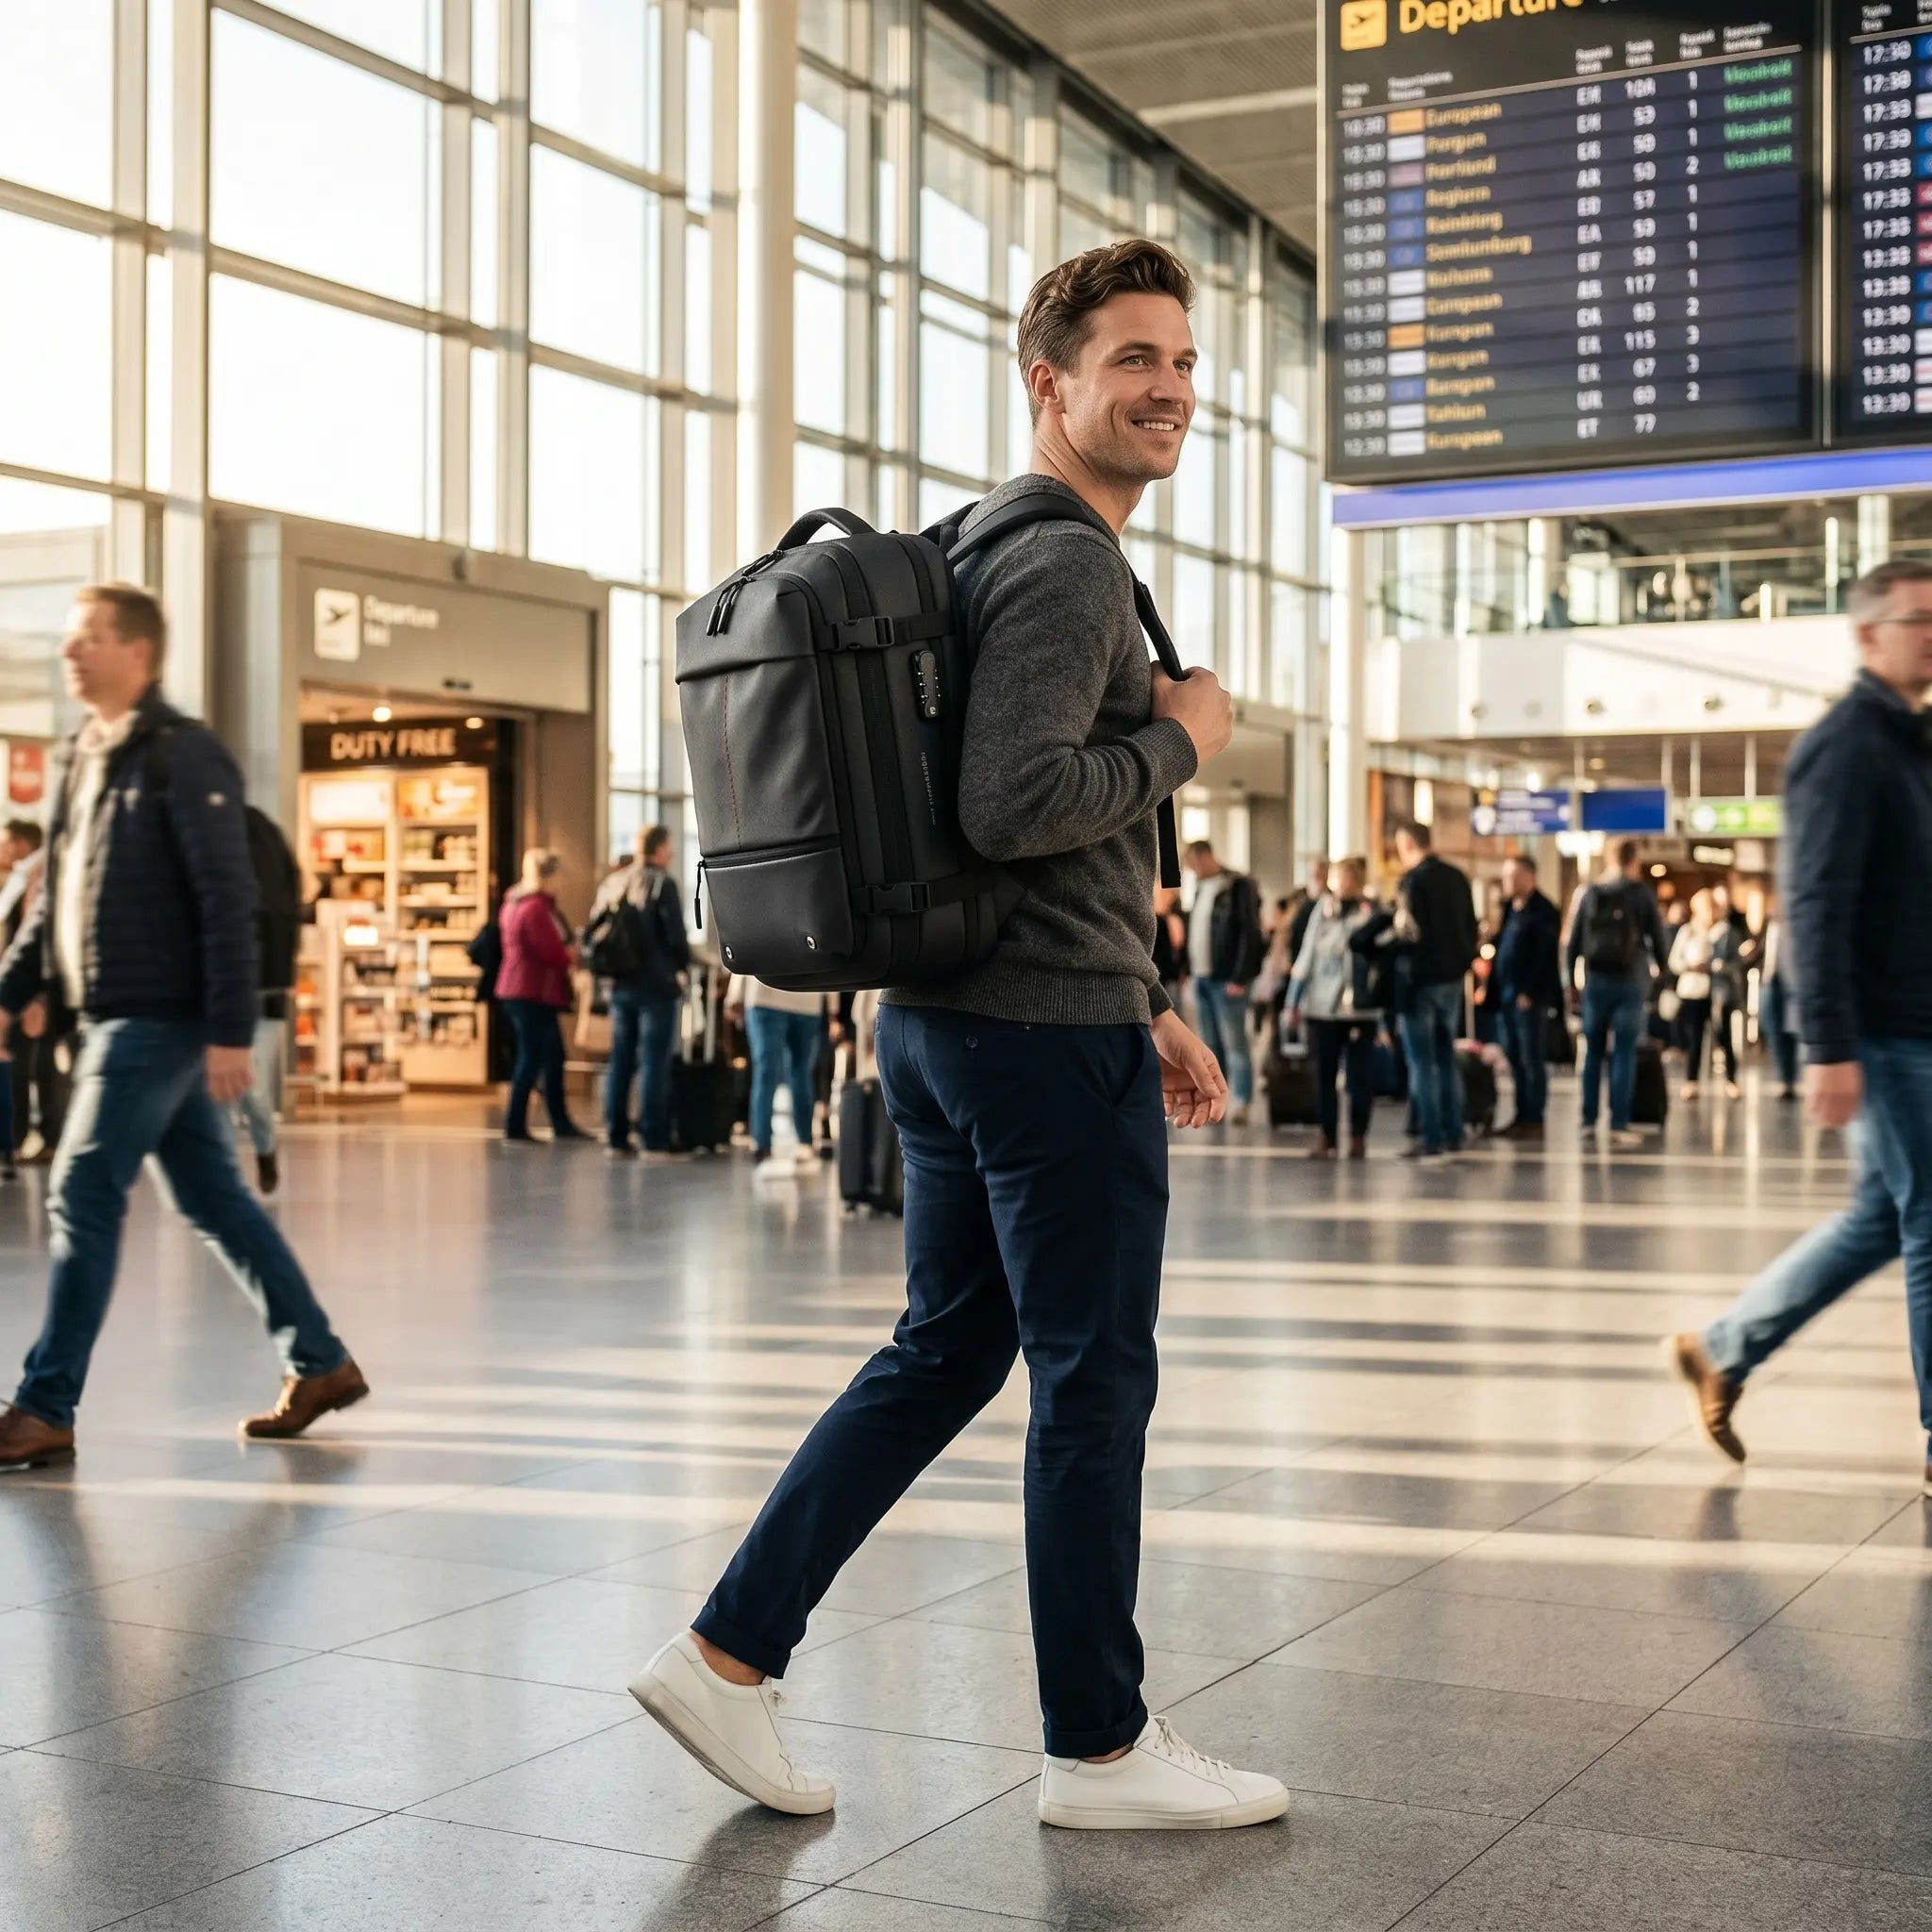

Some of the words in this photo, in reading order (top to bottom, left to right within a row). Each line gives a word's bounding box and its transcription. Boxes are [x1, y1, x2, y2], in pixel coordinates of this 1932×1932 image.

[1399, 0, 1584, 35] Departu
[1689, 71, 1697, 90] 1
[1689, 99, 1697, 118] 1
[1689, 127, 1697, 146] 1
[1687, 156, 1698, 175] 2
[1688, 184, 1697, 203] 1
[1688, 212, 1697, 231] 1
[1688, 241, 1697, 259] 1
[1624, 274, 1656, 294] 117
[1688, 268, 1697, 288] 1
[1687, 297, 1699, 316] 2
[1687, 325, 1699, 344] 3
[1687, 354, 1699, 373] 3
[1687, 382, 1699, 401] 2
[331, 730, 394, 760] DUTY
[396, 727, 457, 757] FREE
